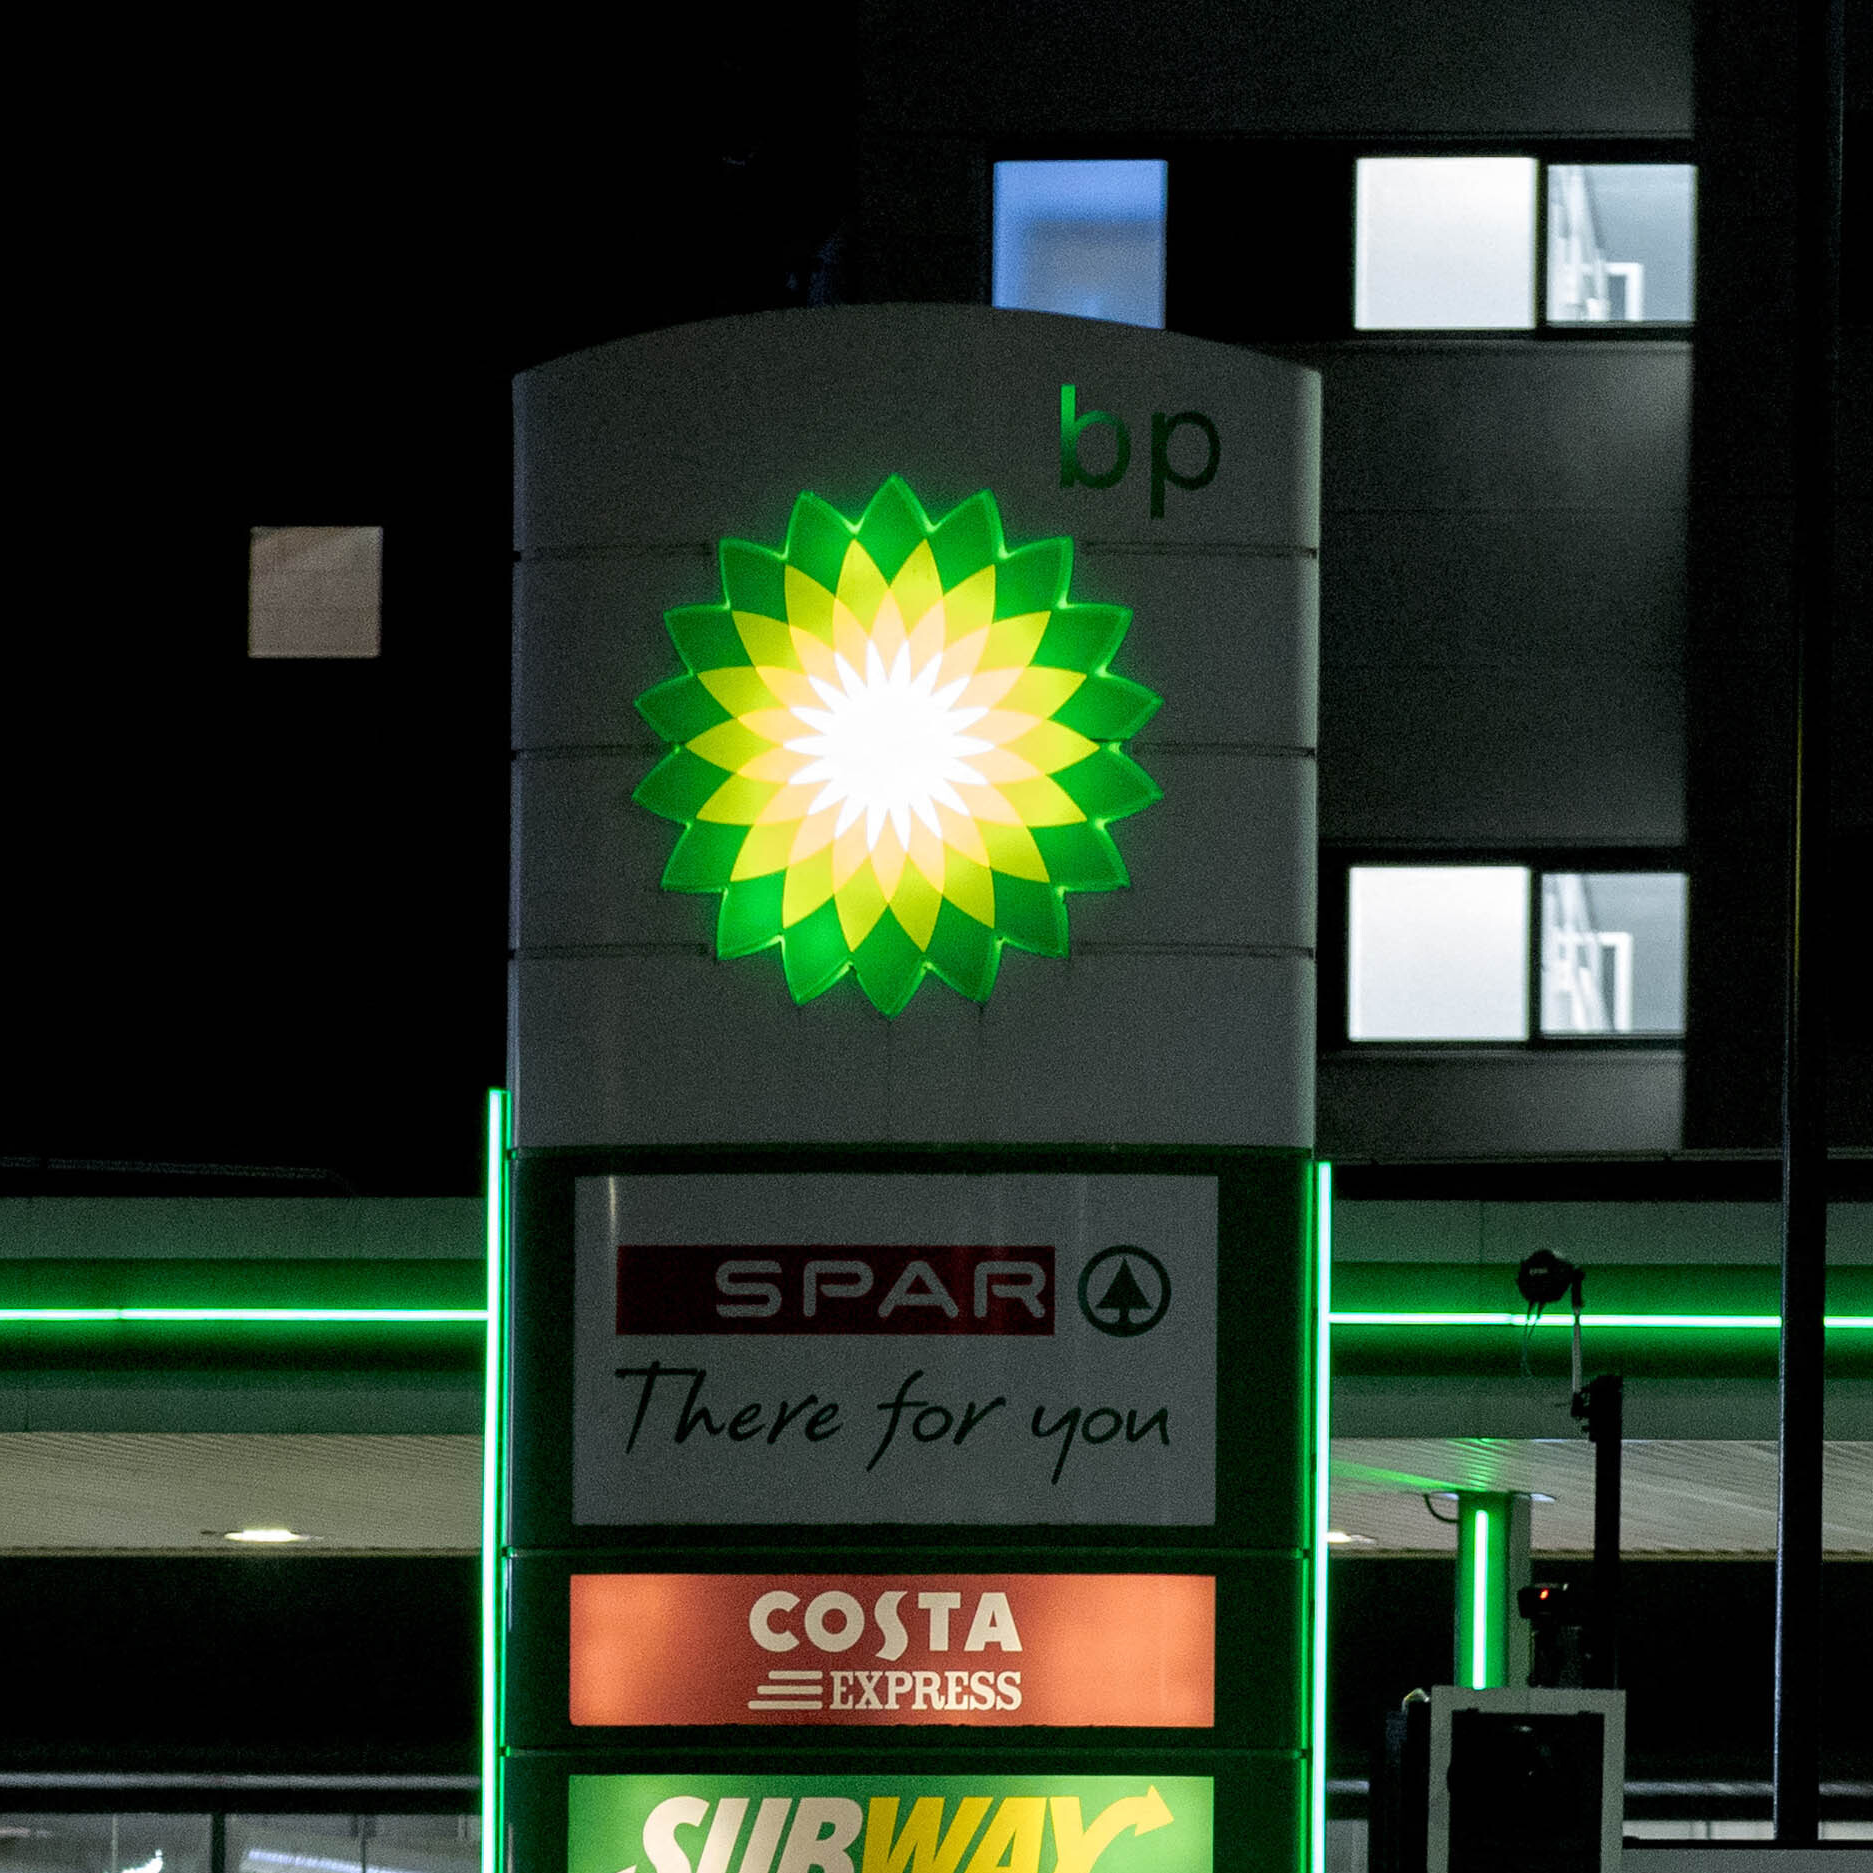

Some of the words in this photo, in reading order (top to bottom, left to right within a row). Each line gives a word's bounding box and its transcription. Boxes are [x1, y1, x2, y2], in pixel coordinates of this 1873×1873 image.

[1059, 382, 1221, 519] bp
[713, 1260, 1047, 1319] SPAR
[613, 1359, 845, 1455] There
[865, 1368, 1007, 1472] for
[1030, 1400, 1172, 1485] you
[747, 1589, 1024, 1662] COSTA
[828, 1670, 1024, 1712] EXPRESS
